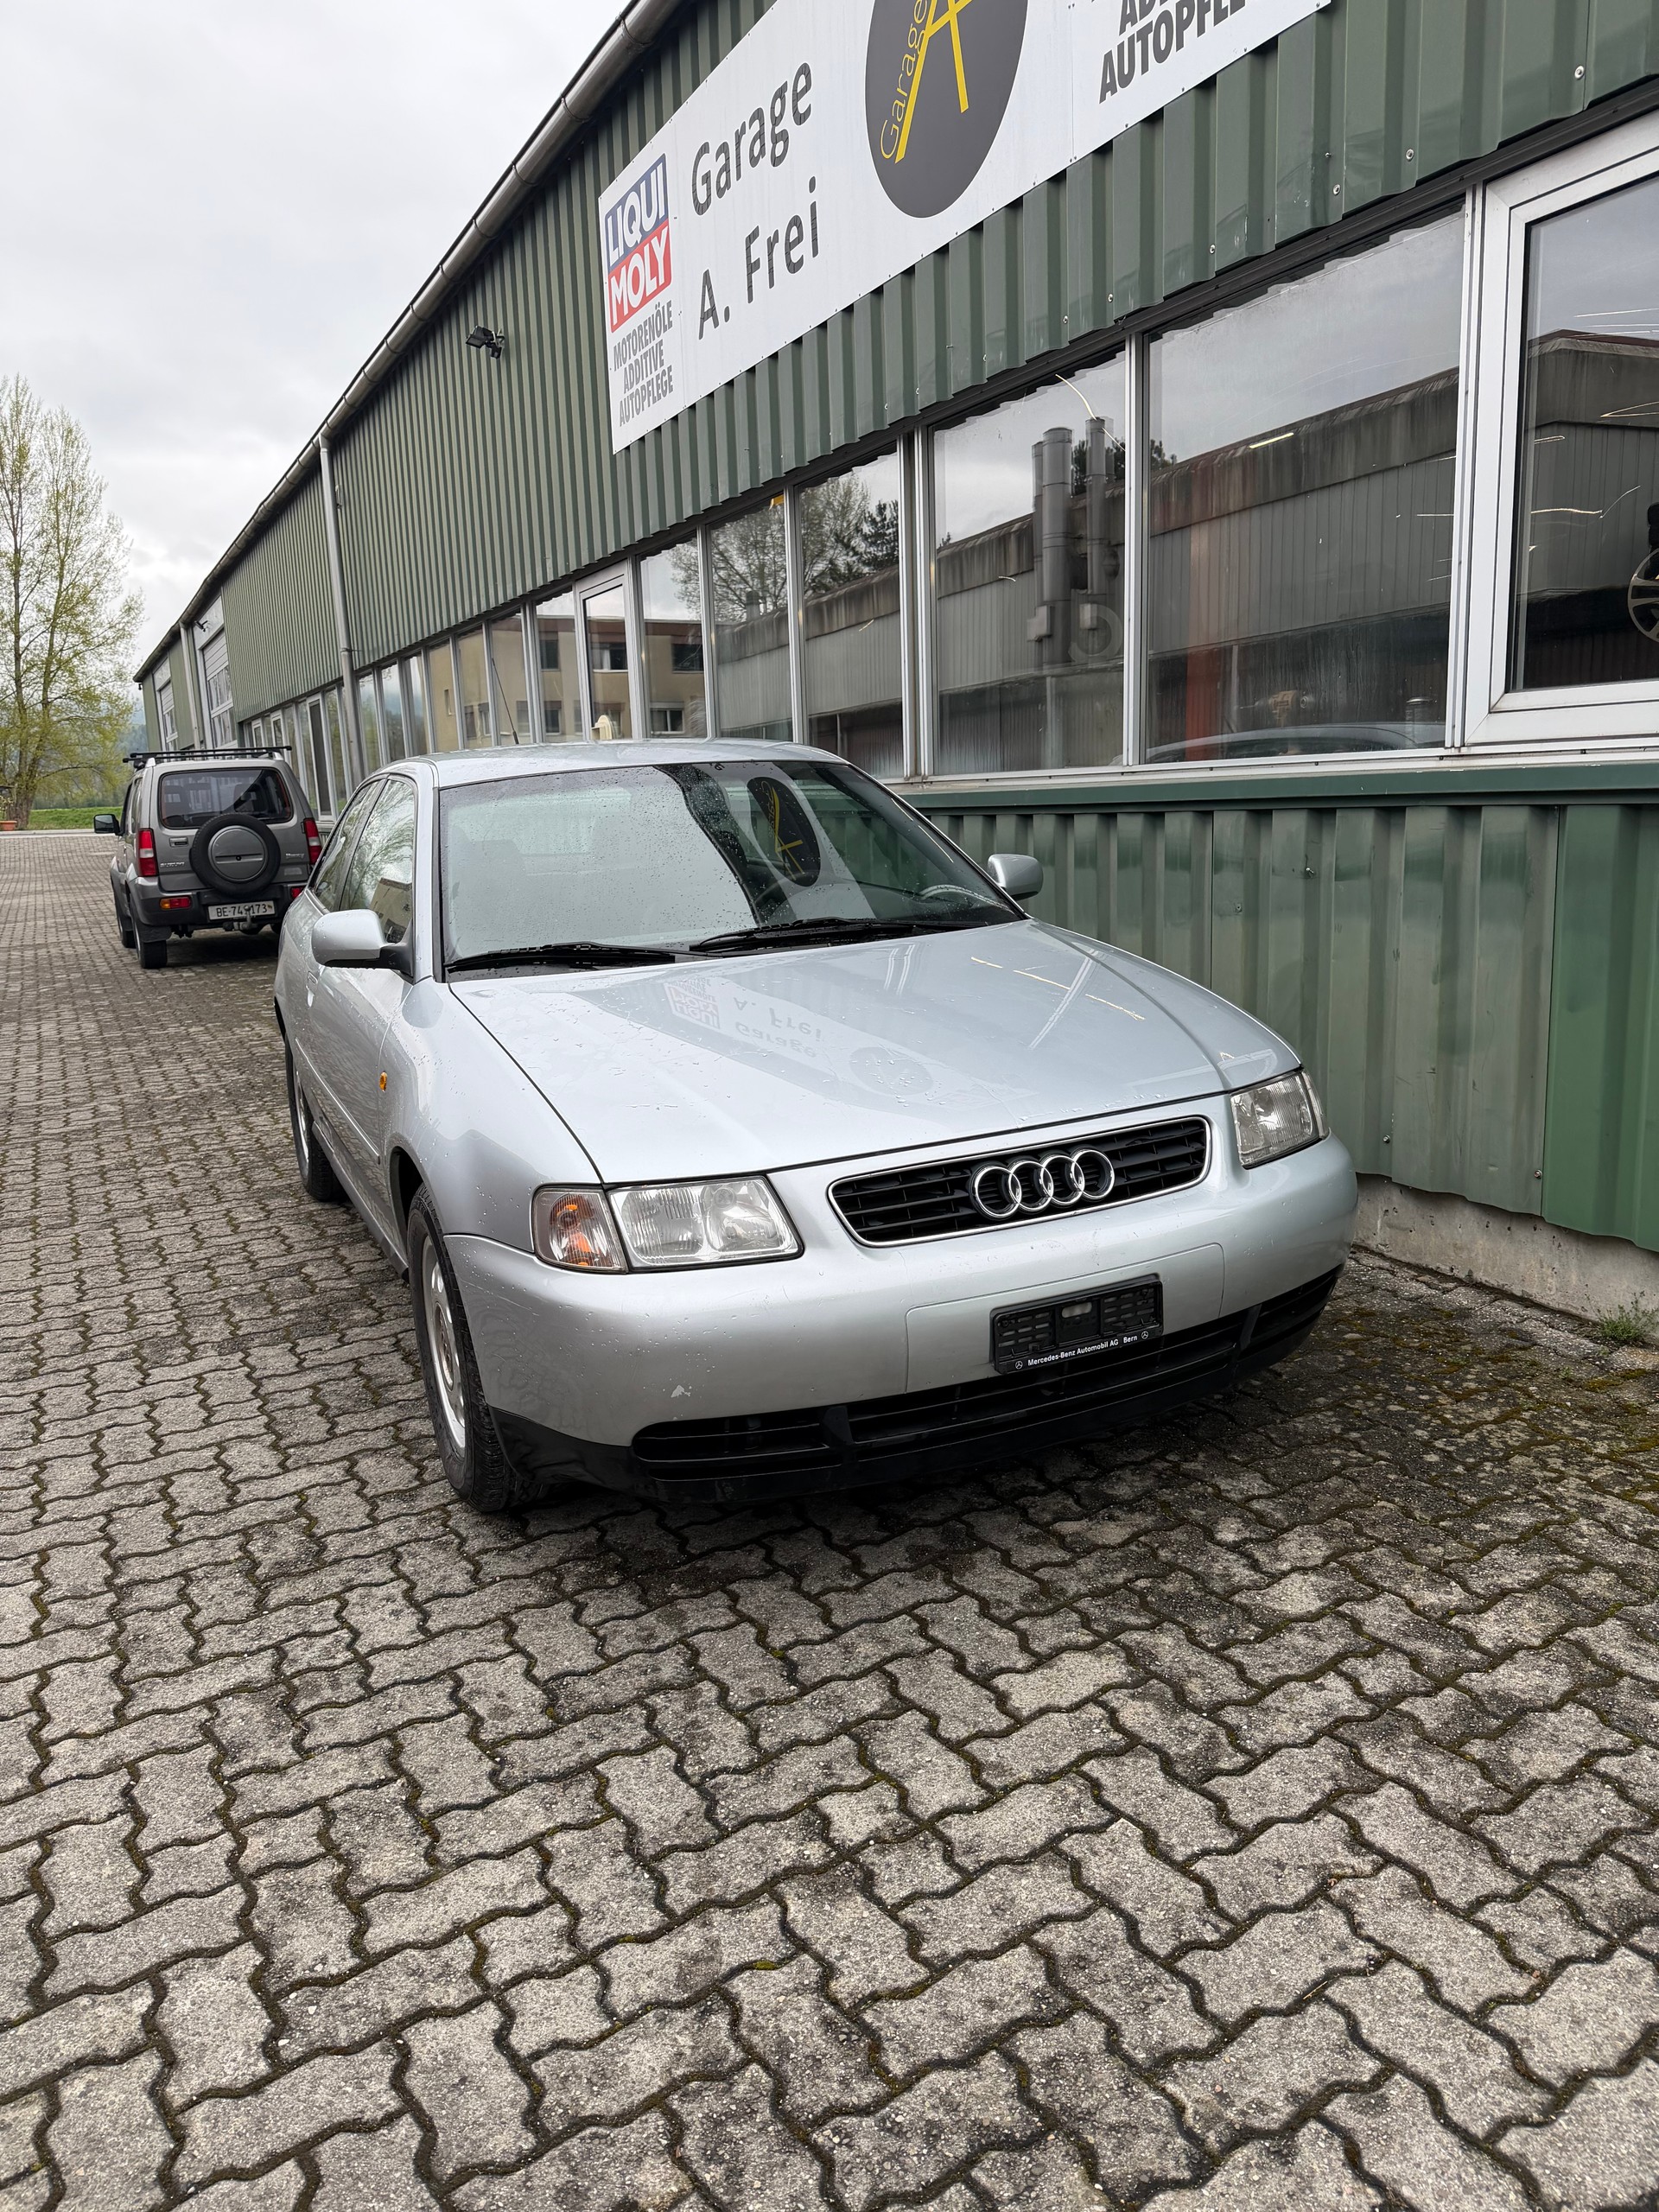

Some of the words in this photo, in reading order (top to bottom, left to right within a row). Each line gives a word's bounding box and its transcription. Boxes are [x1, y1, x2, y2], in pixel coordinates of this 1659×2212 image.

[880, 0, 928, 159] Garage
[691, 62, 812, 216] Garage
[607, 162, 666, 267] LIQUI
[698, 269, 730, 340] A.
[745, 175, 819, 304] Frei
[610, 225, 669, 327] MOLY
[613, 300, 673, 372] MOTORENÖLE
[623, 339, 664, 394] ADDITIVE
[619, 365, 674, 427] AUTOPFLEGE
[1027, 1350, 1076, 1366] Mercedes-Benz
[1077, 1340, 1109, 1355] Automobil
[1109, 1338, 1119, 1347] AG
[1123, 1335, 1138, 1344] Bern
